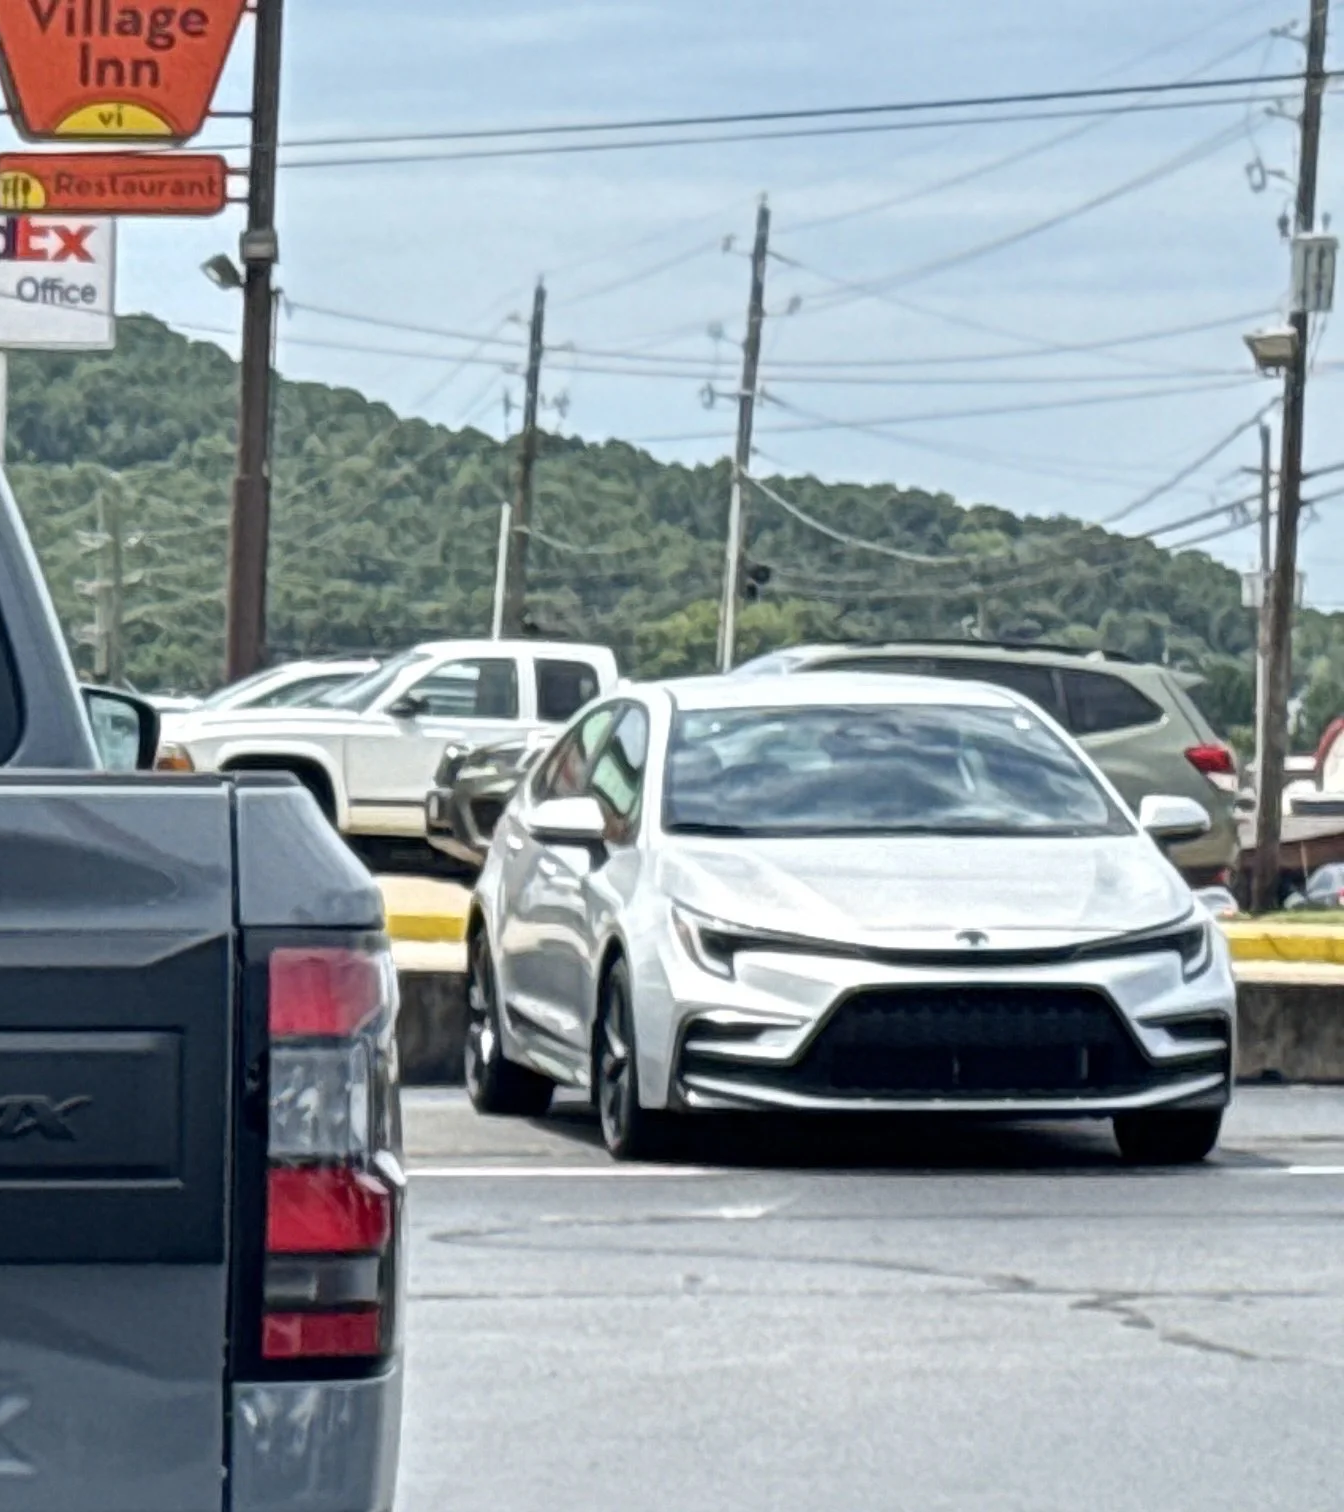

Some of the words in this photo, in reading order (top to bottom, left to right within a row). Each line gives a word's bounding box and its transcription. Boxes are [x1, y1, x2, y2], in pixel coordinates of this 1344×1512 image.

[28, 0, 210, 51] Village
[78, 42, 161, 88] Inn
[96, 104, 123, 129] vi
[54, 171, 218, 198] Restaurant
[16, 276, 98, 305] Office
